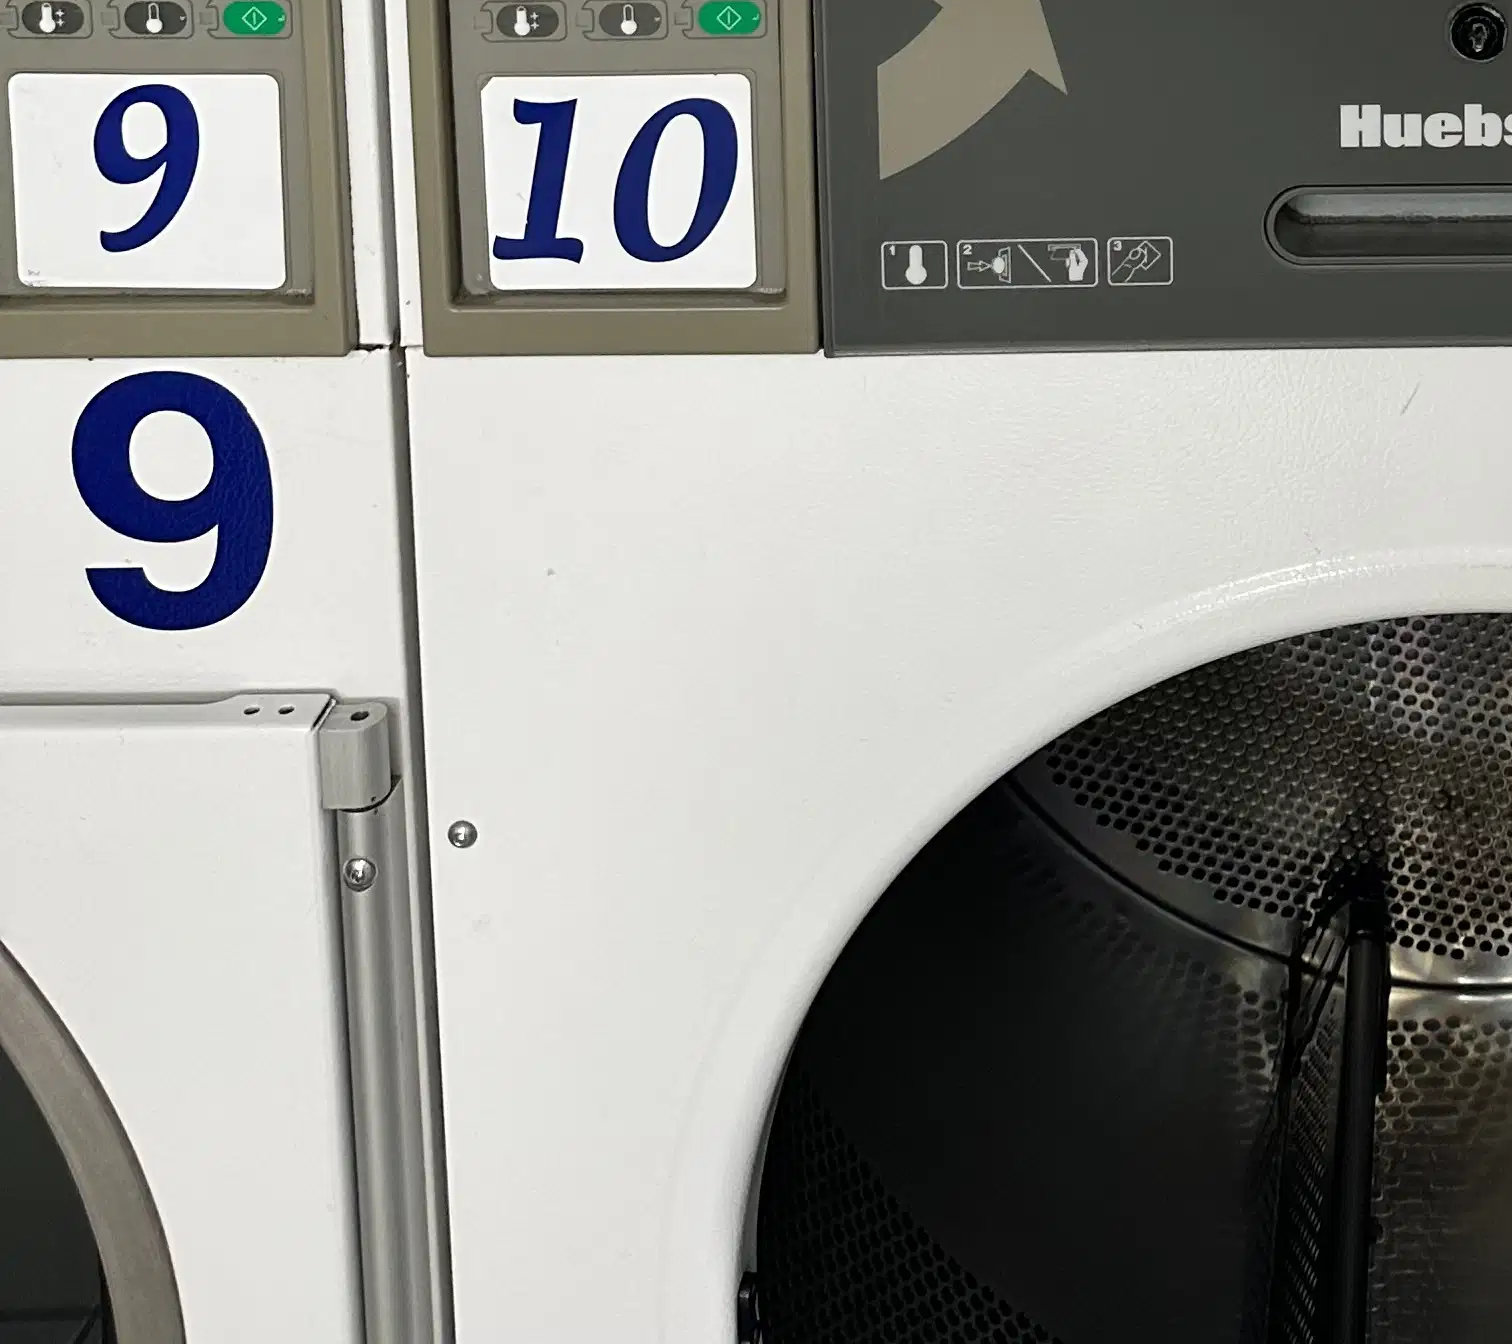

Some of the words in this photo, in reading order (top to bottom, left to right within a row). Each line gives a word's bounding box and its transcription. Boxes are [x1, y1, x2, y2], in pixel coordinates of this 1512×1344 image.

[92, 83, 200, 253] 9
[493, 97, 739, 264] 10
[888, 245, 896, 256] 1
[962, 244, 973, 255] 2
[1112, 240, 1122, 251] 3
[71, 370, 275, 631] 9
